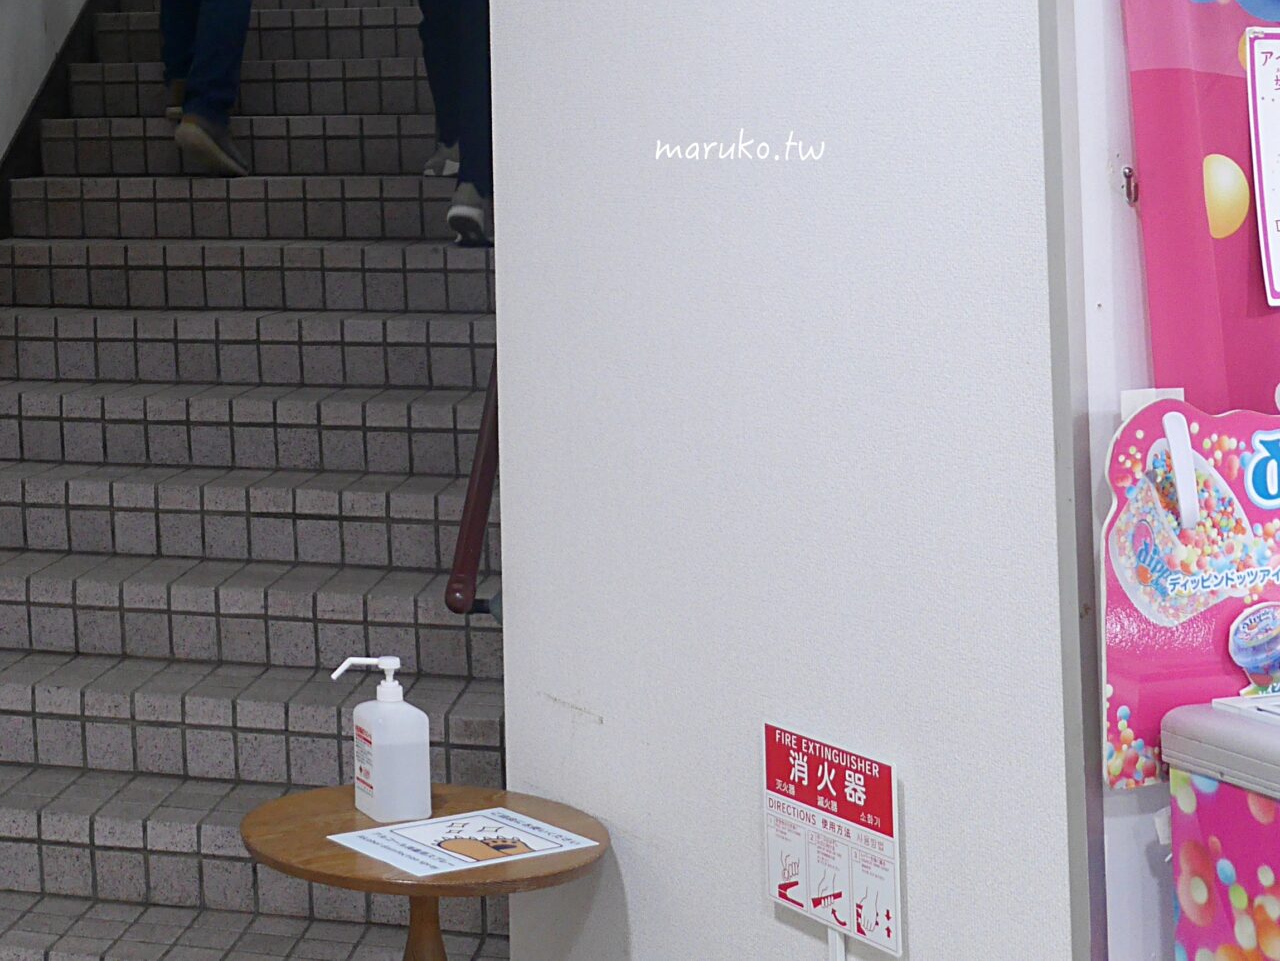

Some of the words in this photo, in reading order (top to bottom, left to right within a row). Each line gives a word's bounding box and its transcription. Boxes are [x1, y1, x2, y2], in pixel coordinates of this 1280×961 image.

[775, 729, 798, 749] FIRE
[801, 738, 880, 778] EXTINGUISHER
[789, 749, 867, 807] 消火器
[768, 797, 817, 826] DIRECTIONS
[821, 817, 852, 839] 使用方法
